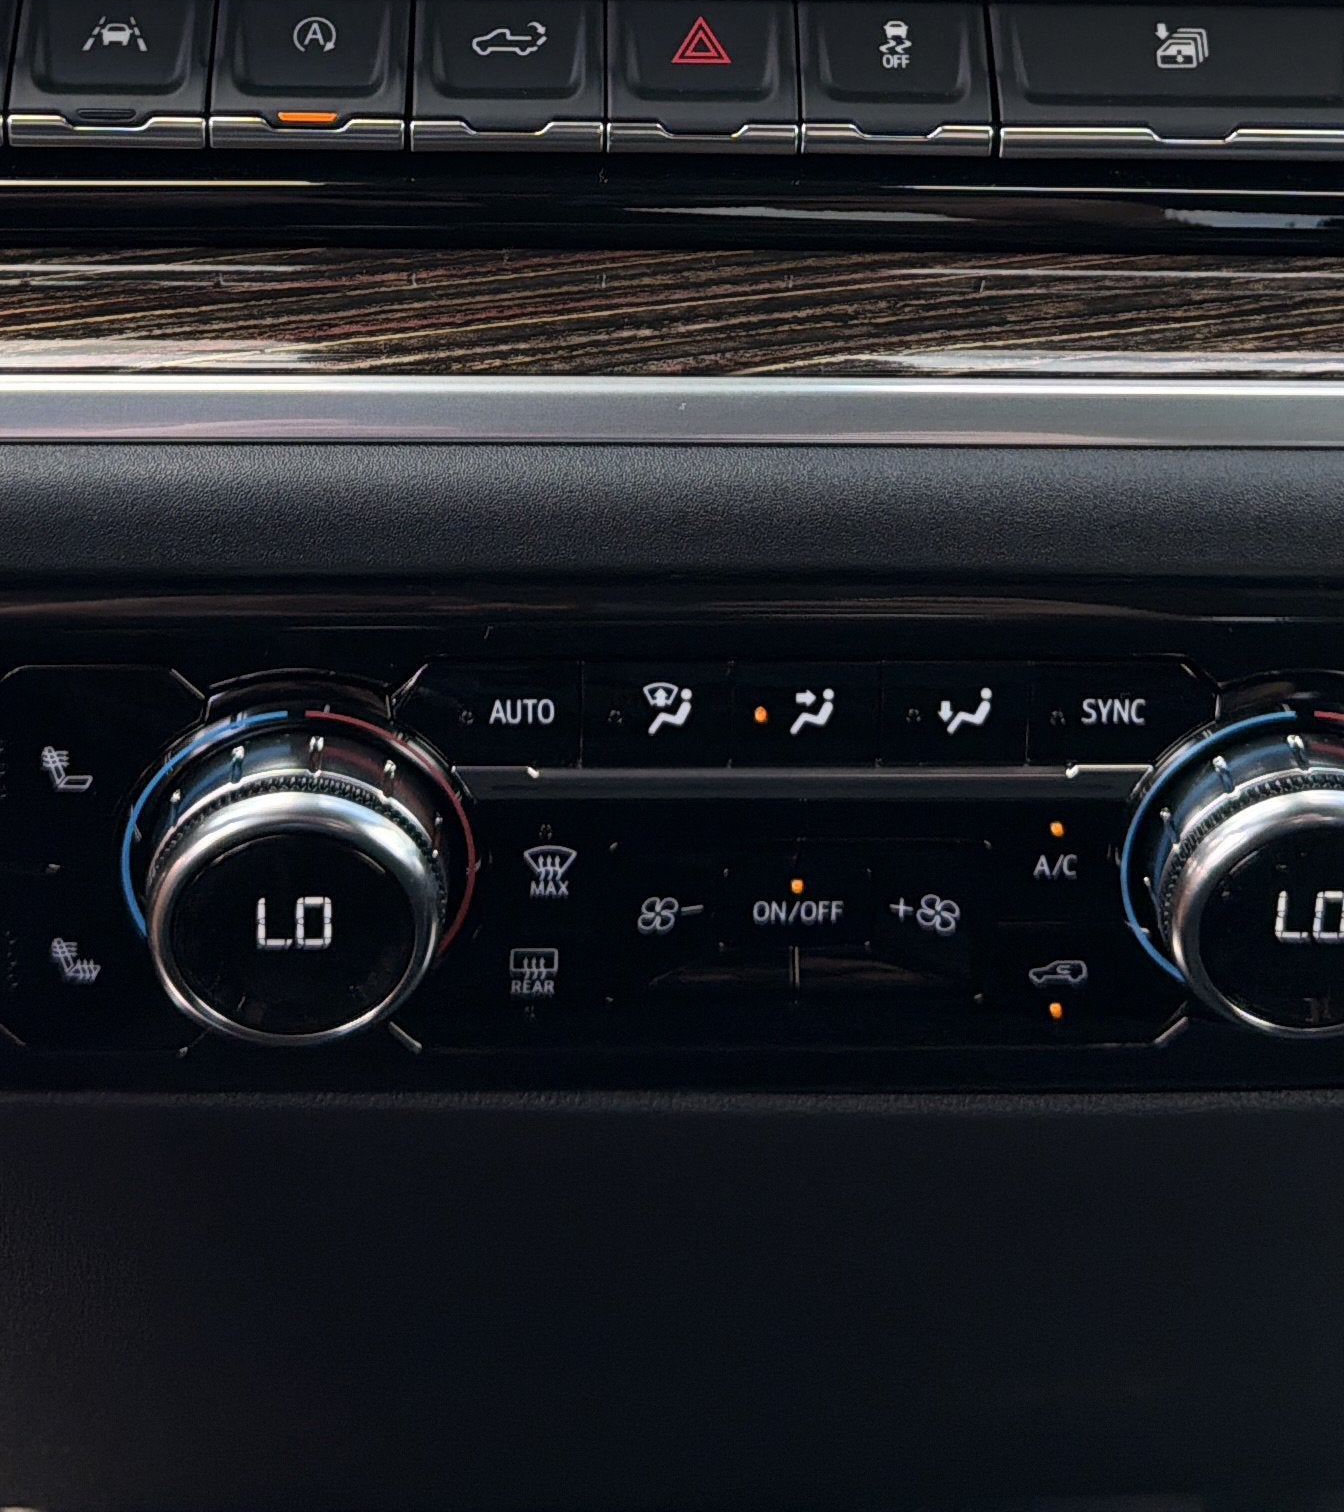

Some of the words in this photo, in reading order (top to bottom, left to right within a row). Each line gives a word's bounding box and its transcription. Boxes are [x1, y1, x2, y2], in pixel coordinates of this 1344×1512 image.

[882, 54, 910, 69] OFF
[489, 698, 555, 725] AUTO
[1081, 698, 1147, 726] SYNC
[1033, 854, 1079, 880] A/C
[529, 880, 570, 898] MAX
[256, 896, 333, 950] LO
[753, 900, 844, 925] ON/OFF
[510, 978, 556, 996] REAR
